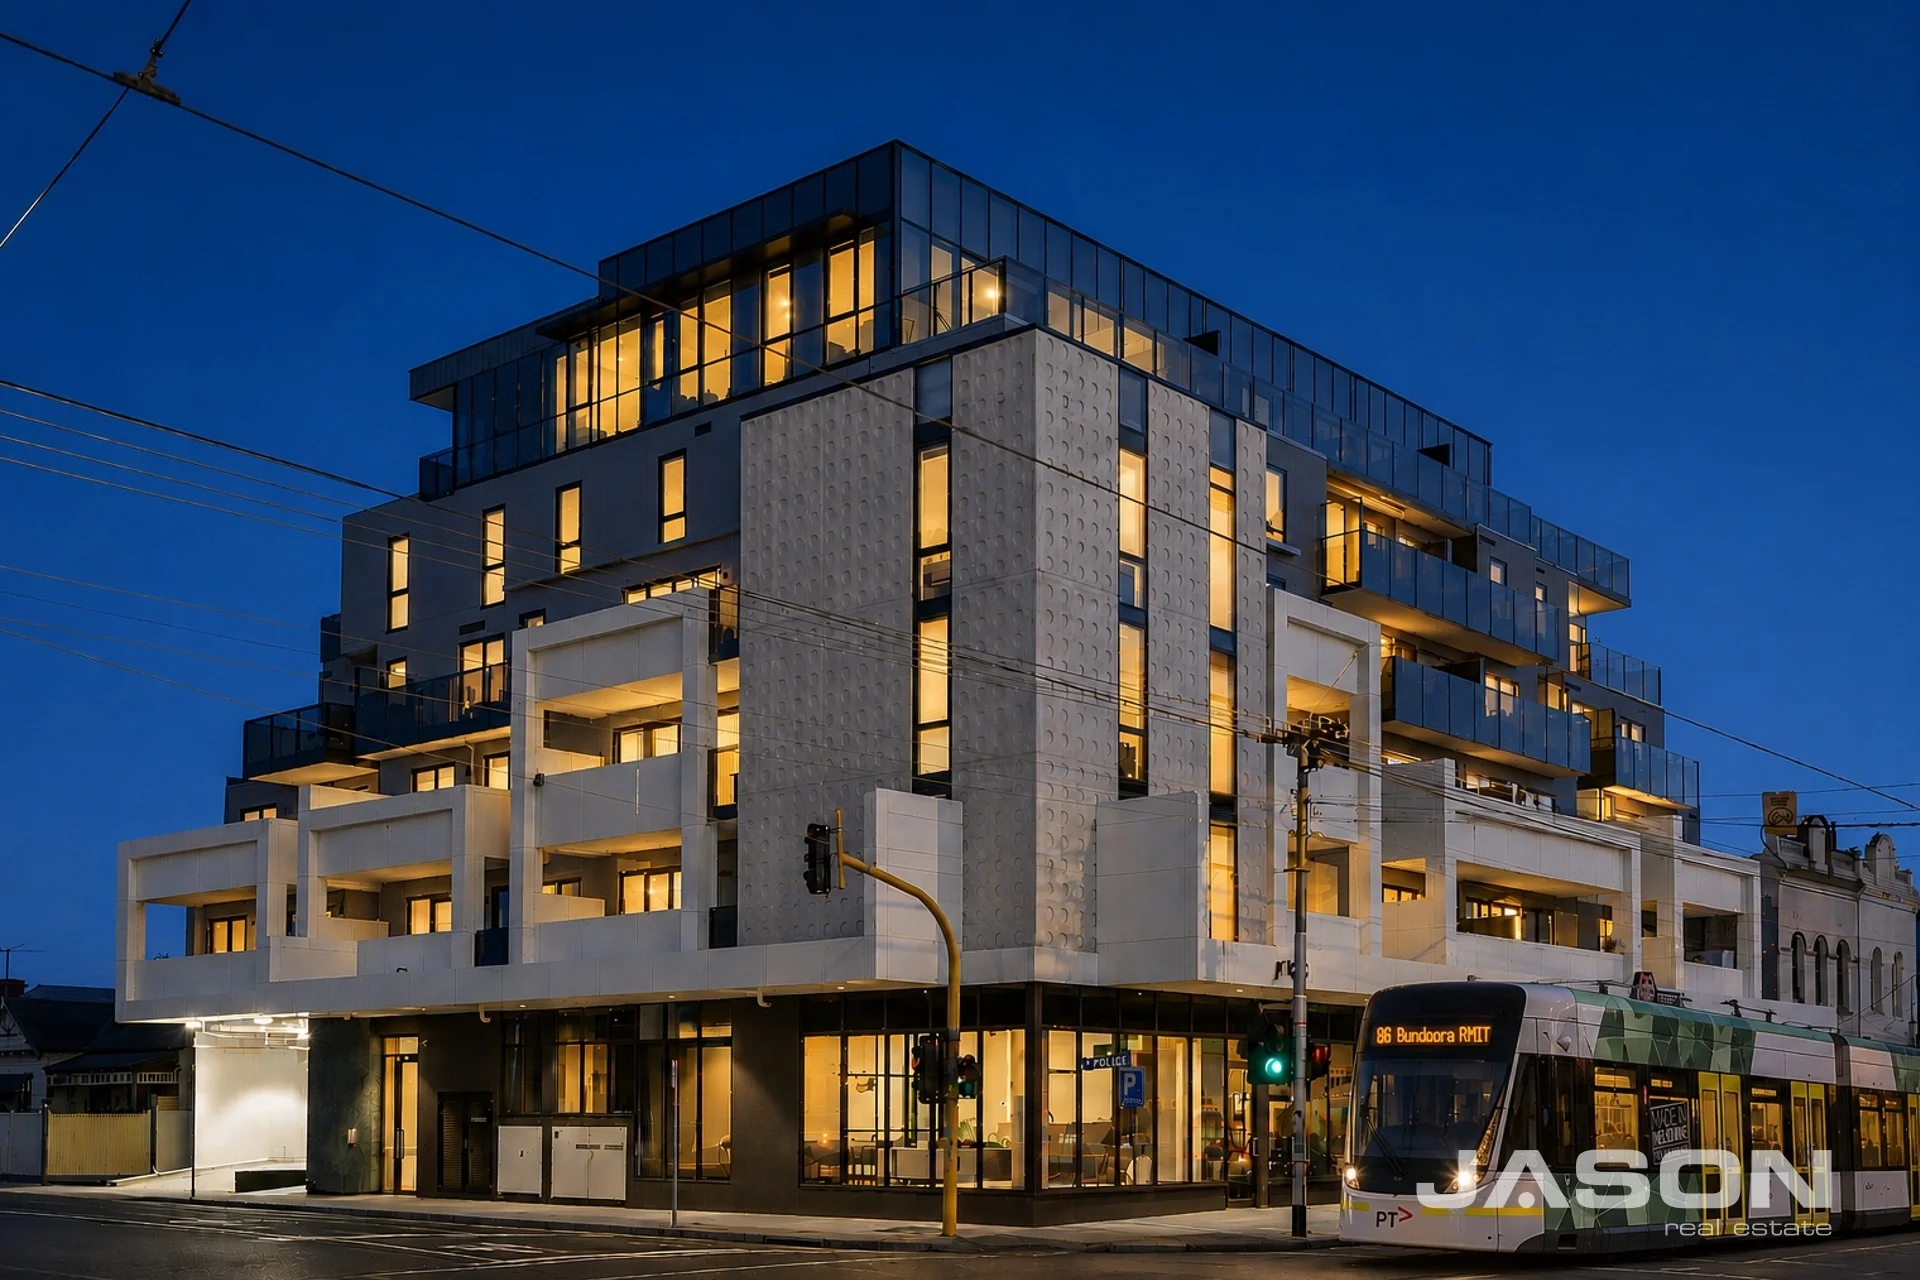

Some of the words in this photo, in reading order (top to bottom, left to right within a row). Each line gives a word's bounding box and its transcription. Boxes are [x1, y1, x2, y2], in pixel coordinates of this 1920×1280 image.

[1376, 1026, 1392, 1044] 86
[1397, 1026, 1455, 1043] Bundoora
[1459, 1026, 1491, 1043] RMIT
[1093, 1055, 1127, 1068] POLICE
[1124, 1072, 1136, 1095] P
